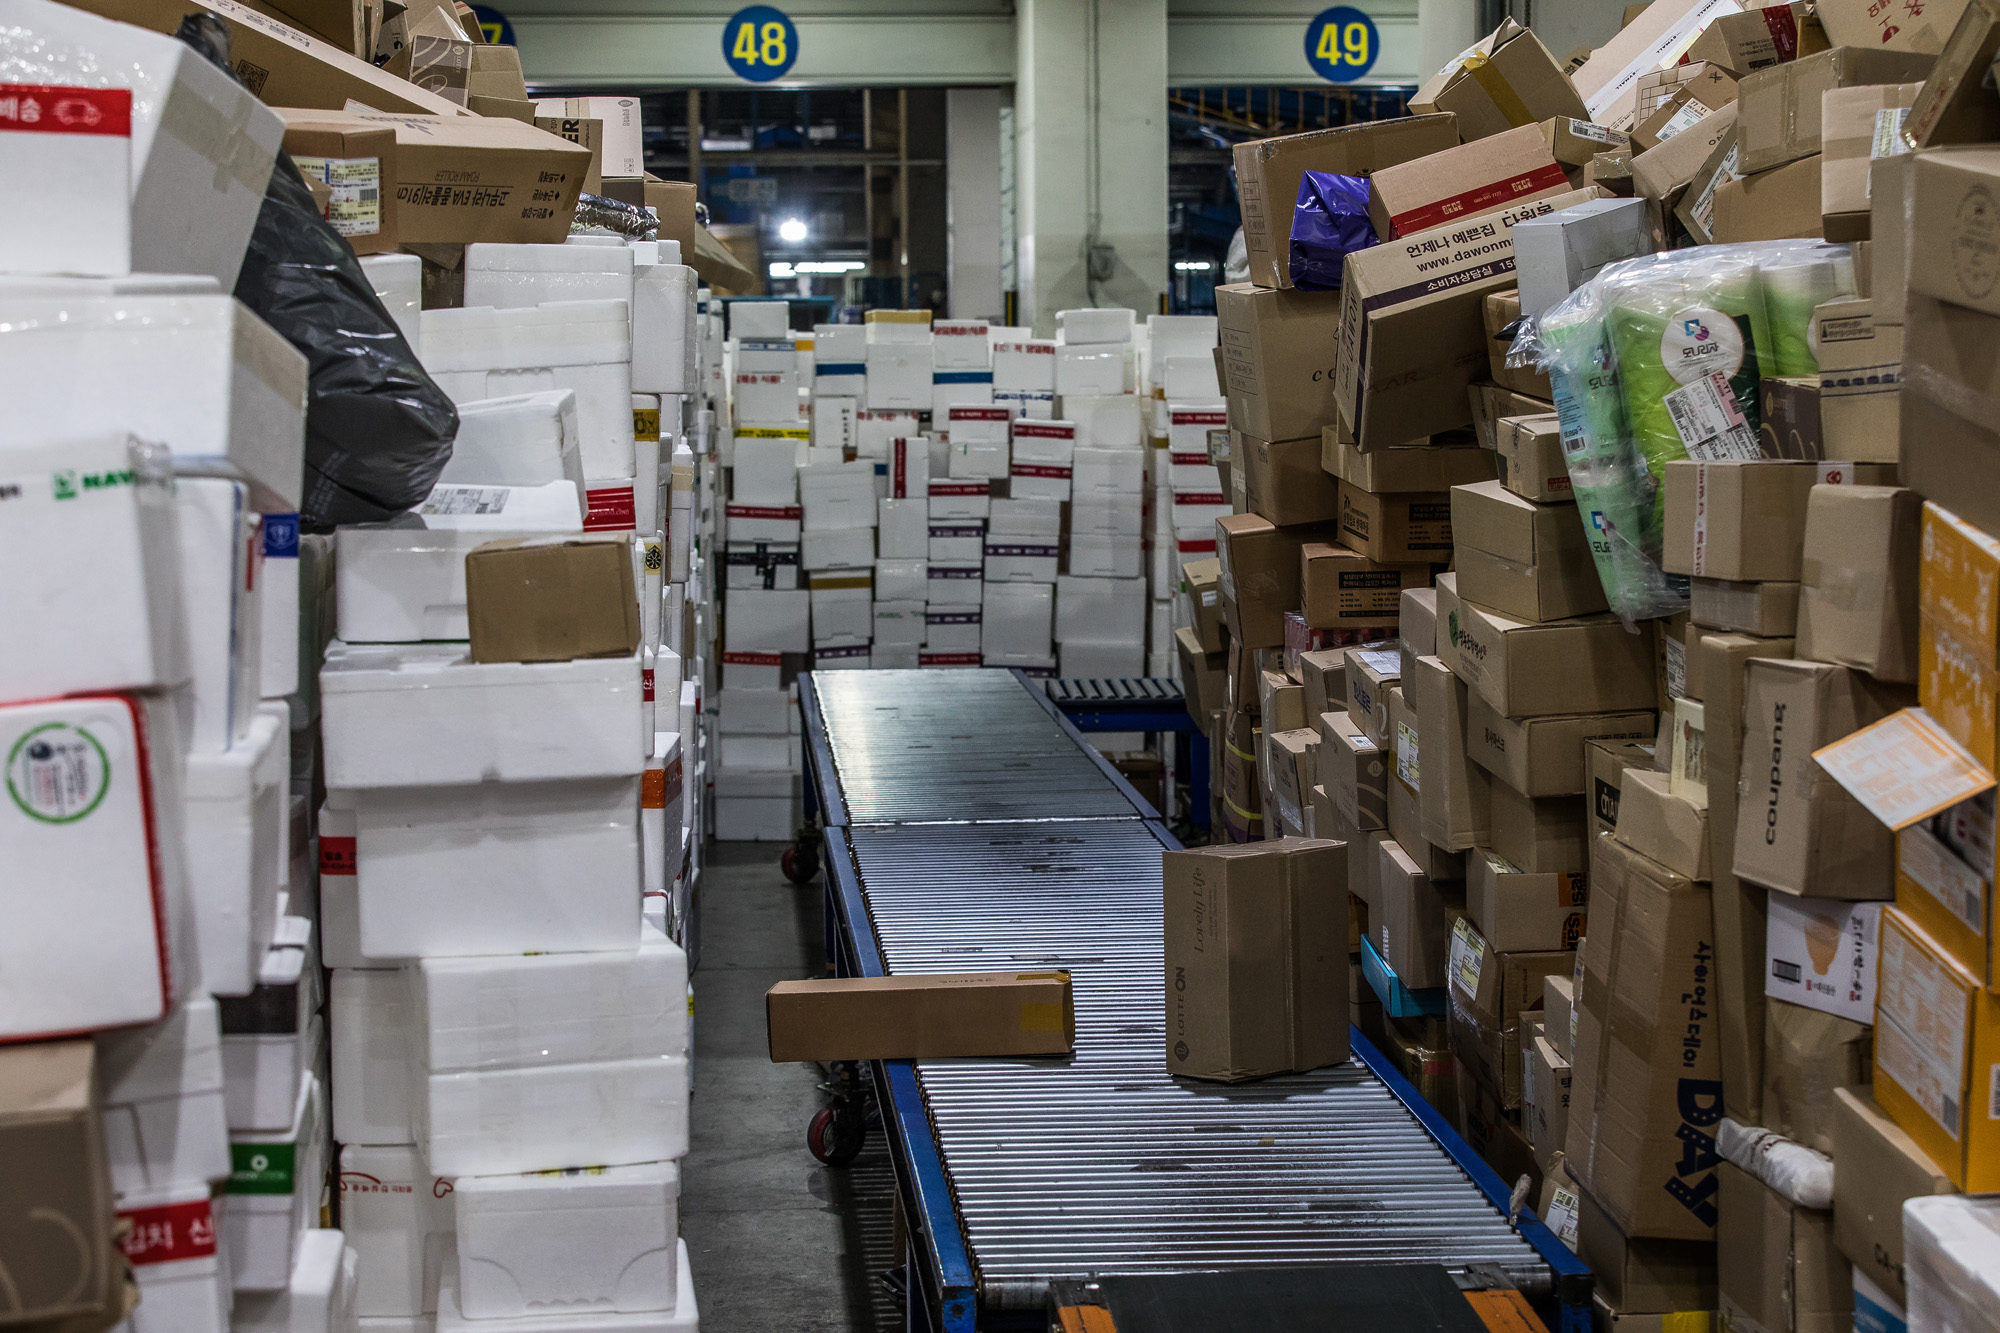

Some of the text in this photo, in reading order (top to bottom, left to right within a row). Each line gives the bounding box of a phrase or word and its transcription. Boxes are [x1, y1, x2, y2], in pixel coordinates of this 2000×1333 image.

[732, 21, 788, 67] 48
[1315, 22, 1371, 66] 49
[434, 170, 480, 181] FOAM ROLLER
[452, 190, 472, 205] EVA
[472, 189, 511, 207] 고무나라
[1406, 236, 1450, 259] 언제나
[1452, 223, 1496, 245] 예쁜집
[1427, 265, 1493, 292] 소비자상담실
[1682, 342, 1720, 358] 모나리자
[1764, 701, 1787, 846] coupang
[1192, 867, 1207, 954] Lovely Life
[1681, 940, 1712, 1068] 사이언스데이
[1664, 1077, 1725, 1229] DAY
